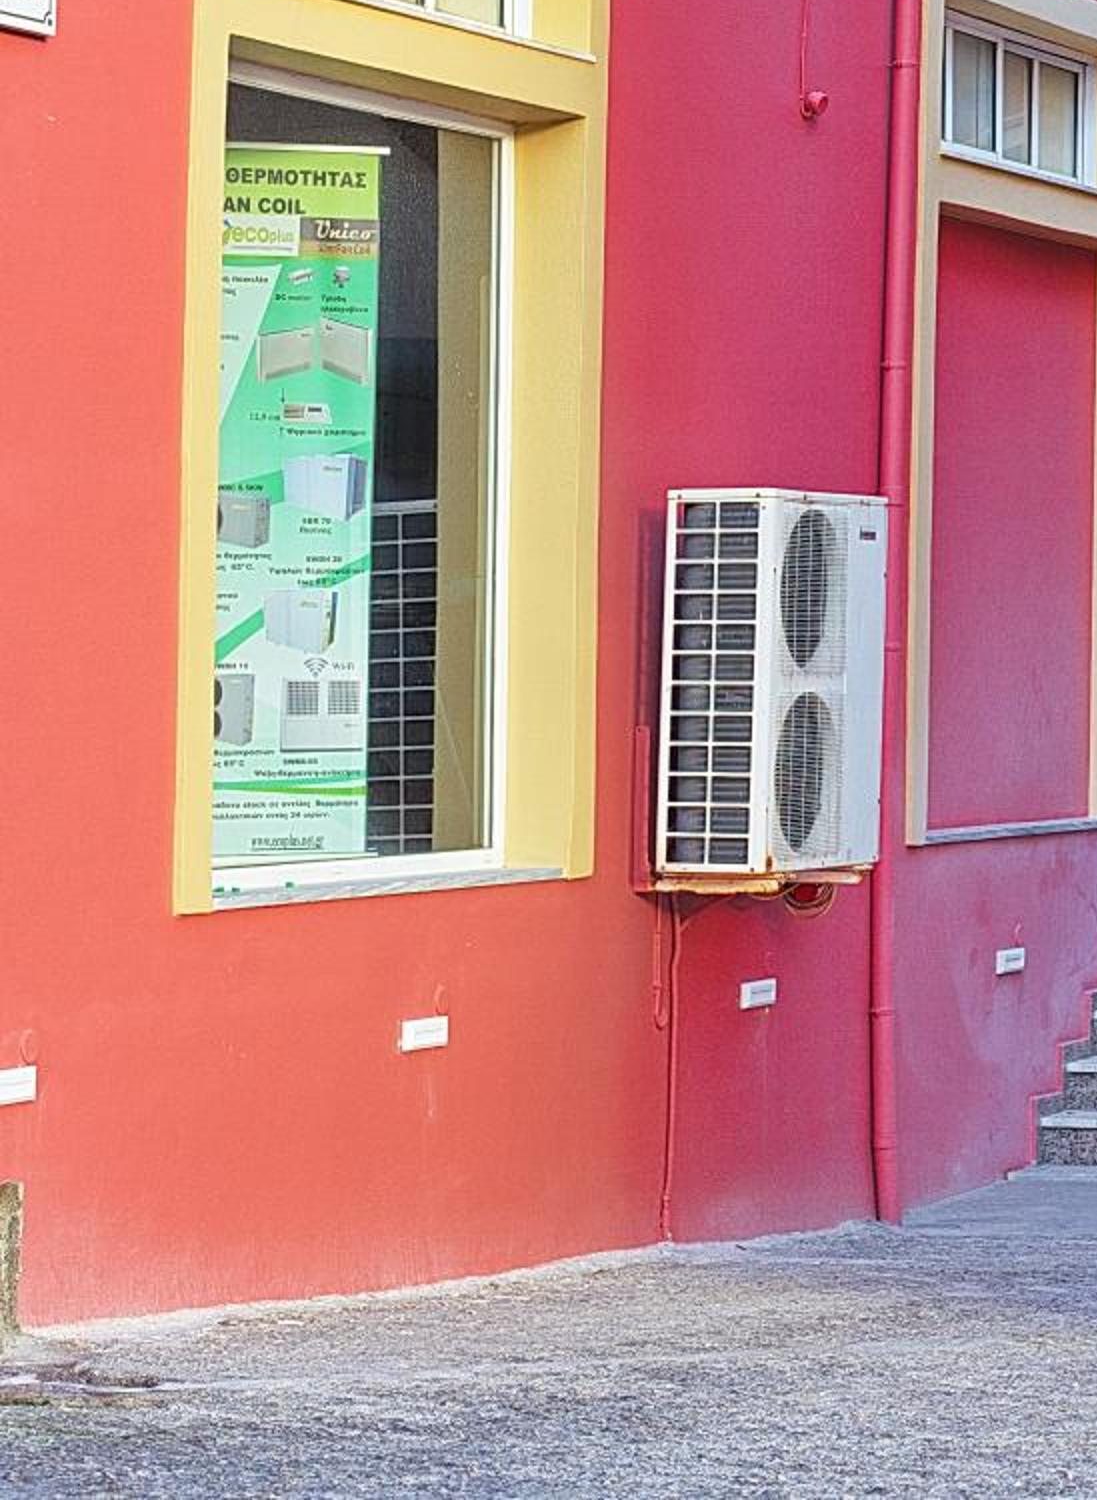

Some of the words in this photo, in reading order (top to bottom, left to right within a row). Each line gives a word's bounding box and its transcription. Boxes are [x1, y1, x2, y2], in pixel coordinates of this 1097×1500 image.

[225, 167, 367, 189] ΘΕΡΜΟΤΗΤΑΣ
[257, 197, 307, 215] COIL
[314, 219, 377, 241] Unico
